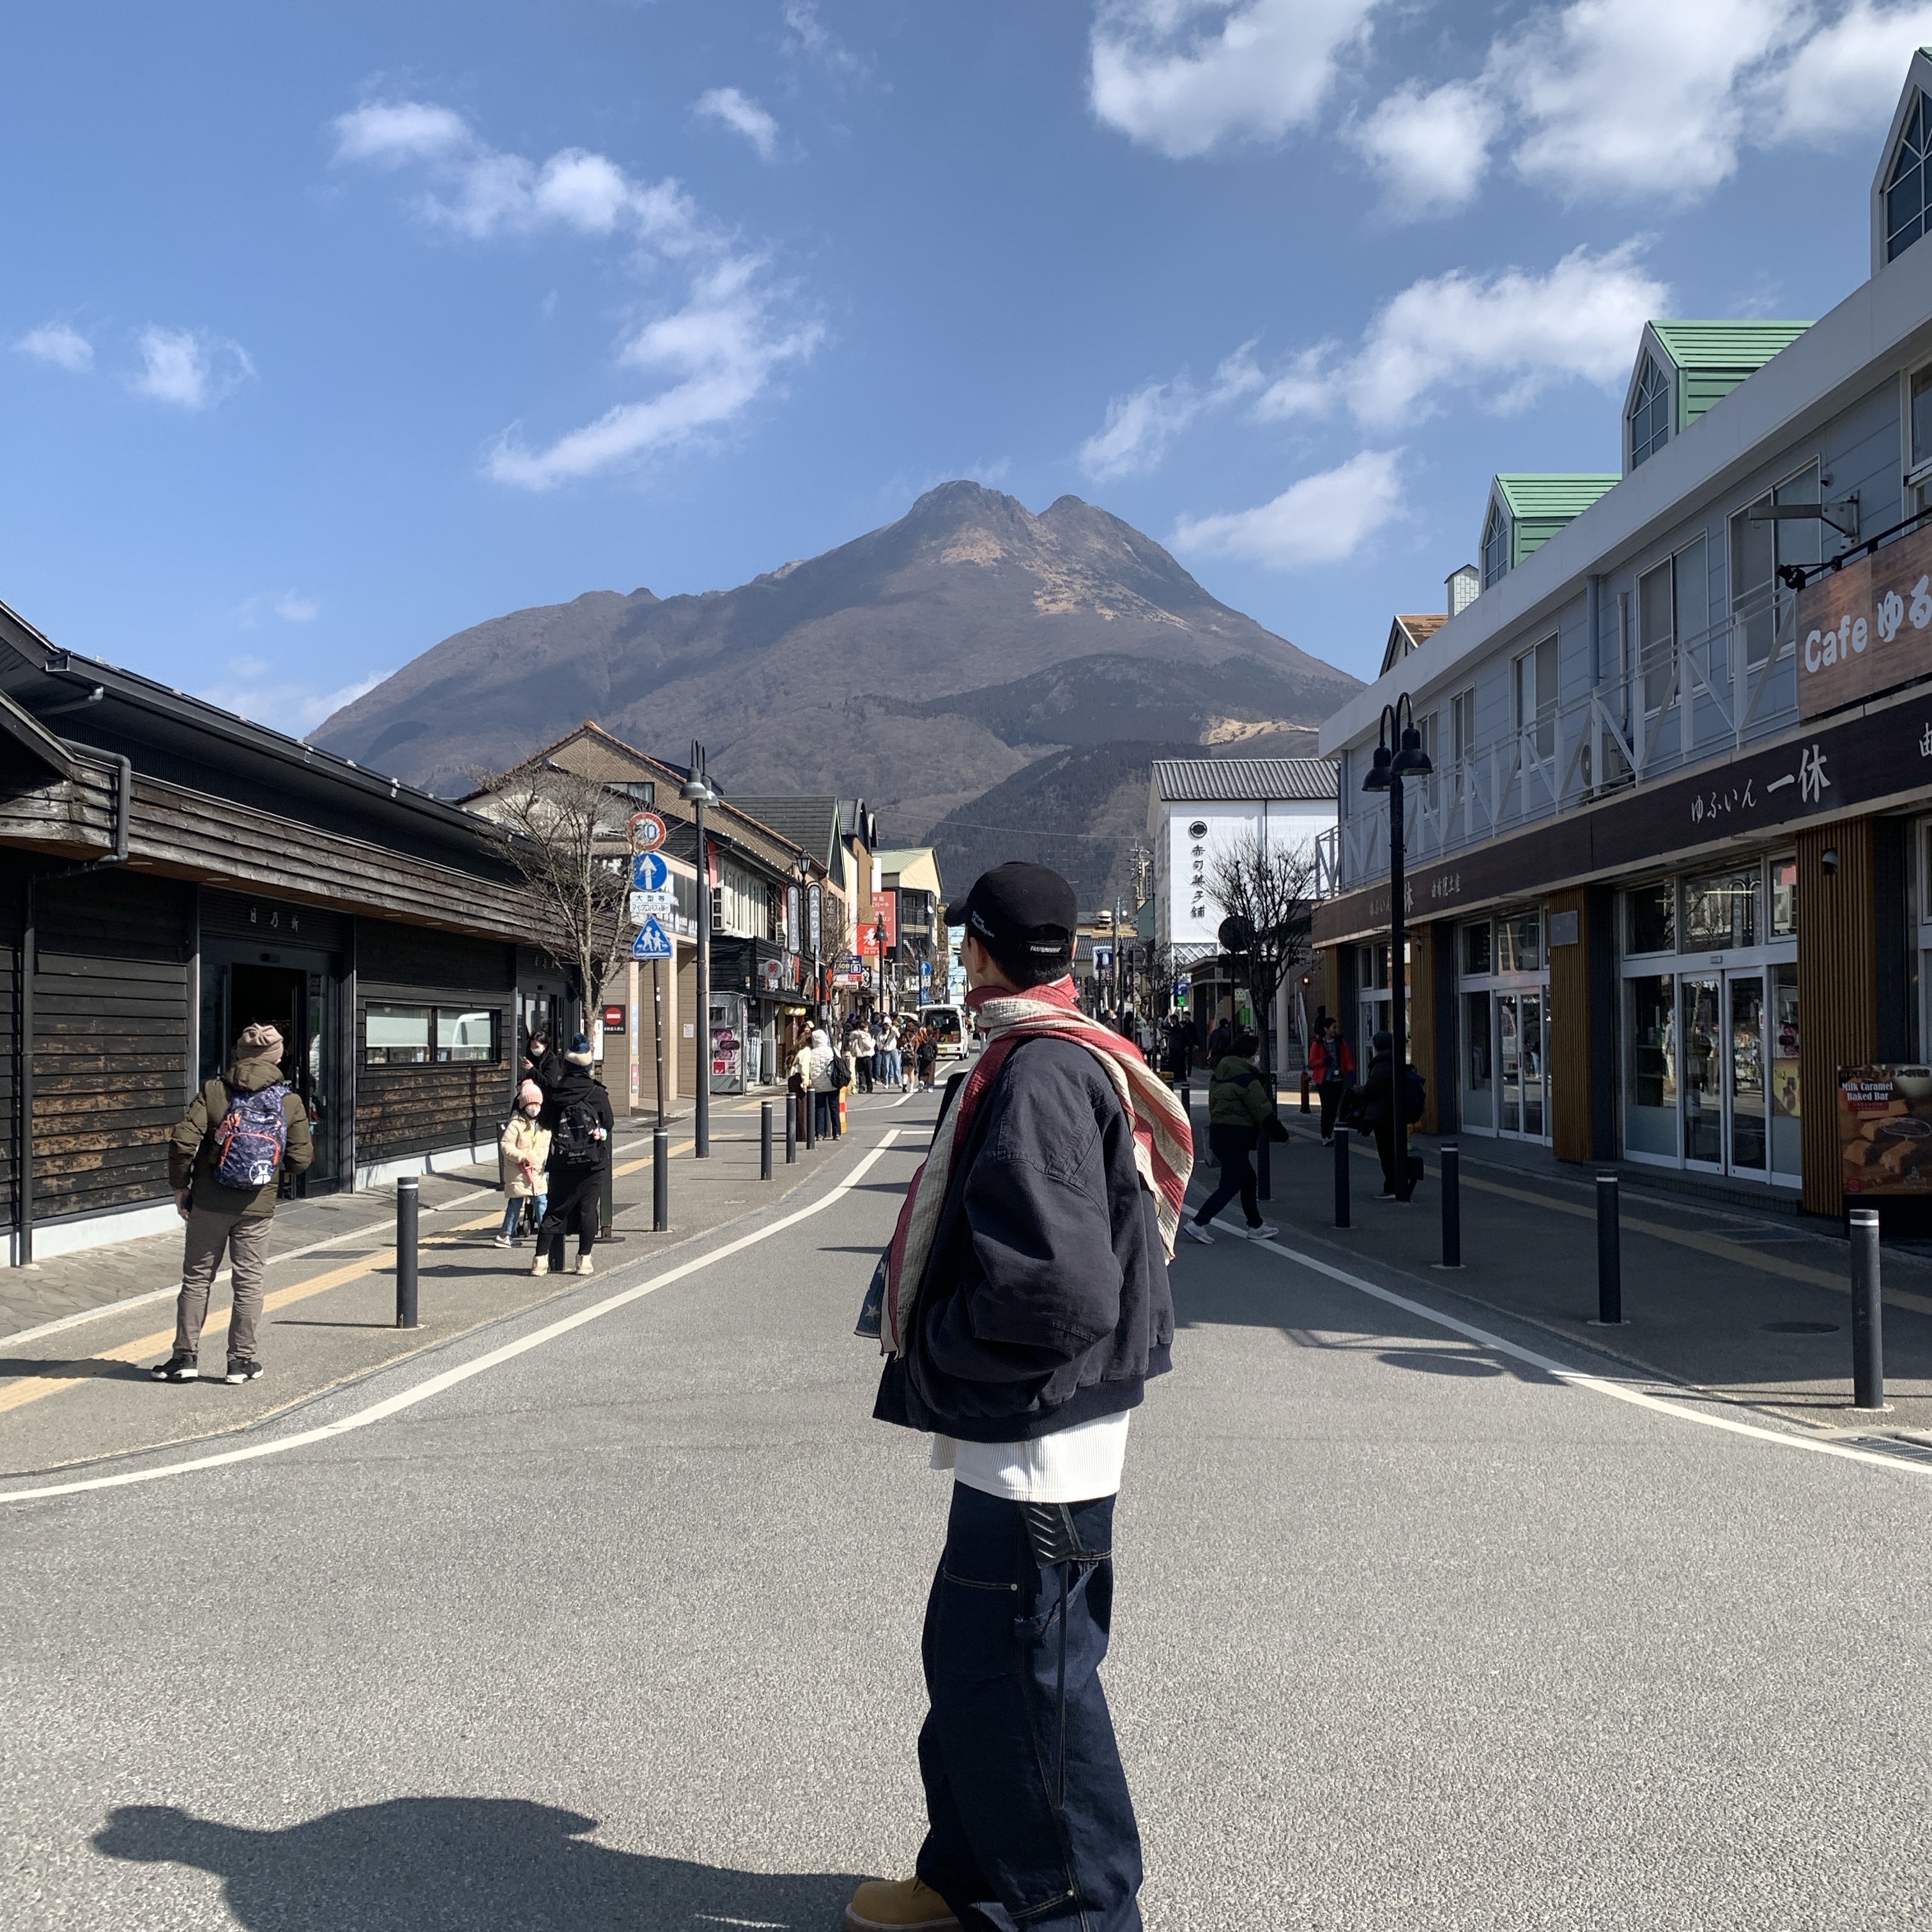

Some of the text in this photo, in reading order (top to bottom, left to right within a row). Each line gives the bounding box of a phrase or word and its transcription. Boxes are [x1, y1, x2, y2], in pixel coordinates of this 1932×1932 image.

[1805, 615, 1867, 673] Cafe
[1691, 779, 1757, 824] ゆふいん
[1767, 744, 1831, 803] 一休
[811, 889, 819, 939] バスのりば
[1842, 1082, 1894, 1091] Milk Caramel
[1846, 1092, 1889, 1101] Baked Bar
